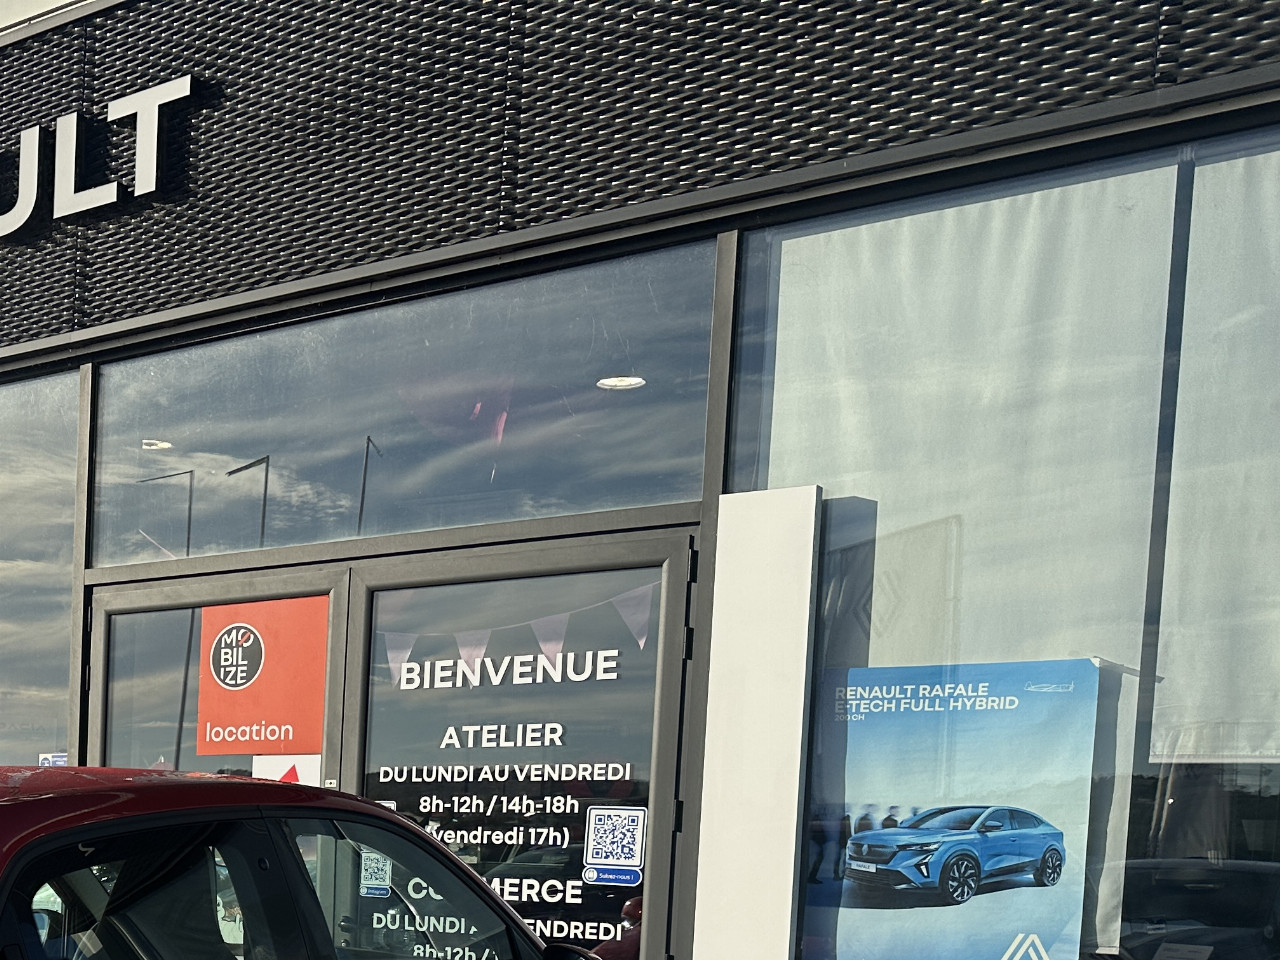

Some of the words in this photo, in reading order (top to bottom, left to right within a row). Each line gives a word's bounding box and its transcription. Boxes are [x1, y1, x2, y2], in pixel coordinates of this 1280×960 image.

[220, 647, 248, 666] BIL
[220, 666, 248, 685] IZE
[399, 649, 620, 691] BIENVENUE
[835, 684, 916, 700] RENAULT
[919, 682, 990, 698] RAFALE
[834, 700, 896, 714] E-TECH
[900, 698, 945, 712] FULL
[949, 696, 1019, 711] HYBRID
[205, 720, 293, 742] location
[439, 722, 564, 749] ATELIER
[379, 765, 410, 783] DU
[411, 765, 474, 783] LUNDI
[478, 764, 509, 782] AU
[514, 763, 631, 782] VENDREDI
[419, 796, 484, 813] 8h-12h
[500, 794, 579, 814] 14h-18h
[528, 826, 570, 849] 17h)
[372, 912, 400, 930] DU
[404, 914, 466, 934] LUNDI
[526, 918, 622, 941] ENDREDI
